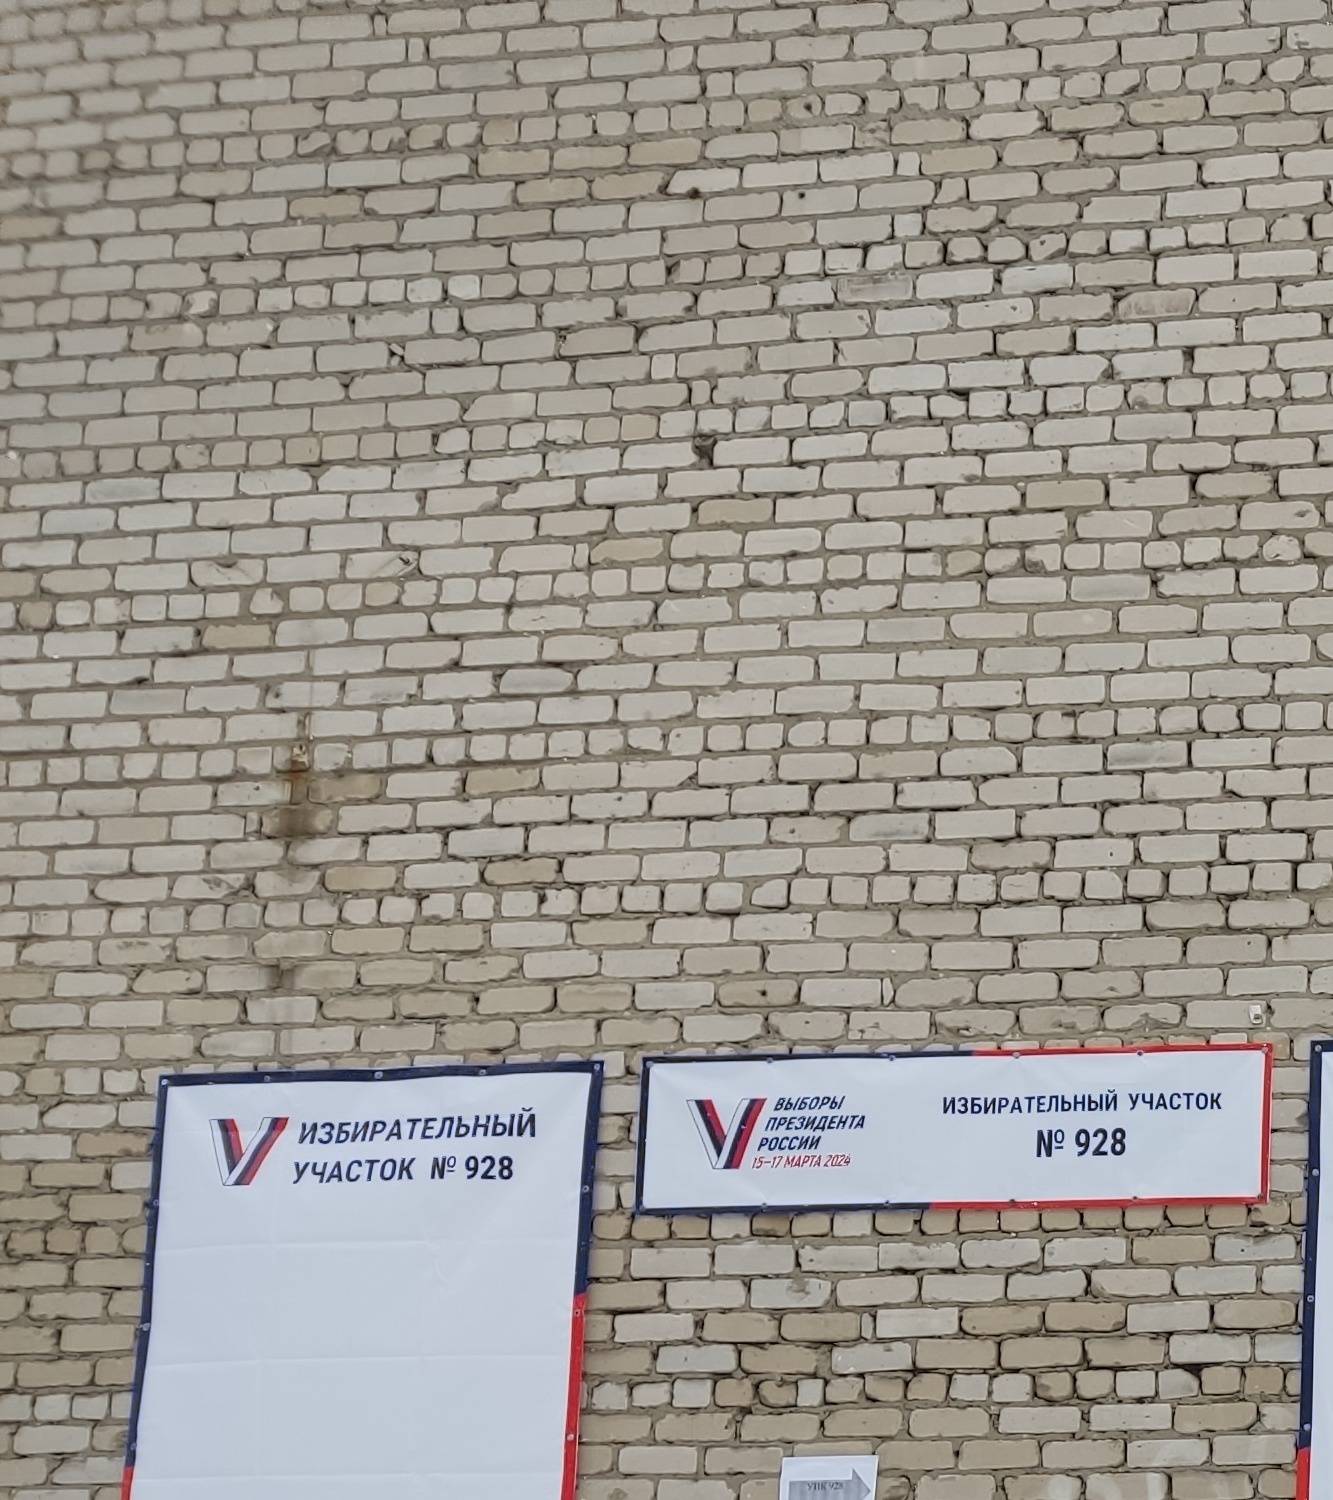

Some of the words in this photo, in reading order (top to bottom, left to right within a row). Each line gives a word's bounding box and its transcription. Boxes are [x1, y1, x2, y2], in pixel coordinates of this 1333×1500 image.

[773, 1096, 845, 1111] ВЫБОРЫ
[943, 1087, 1117, 1114] ИЗБИРАТЕЛЬНЫЙ
[1128, 1093, 1222, 1111] УЧАСТОК
[298, 1107, 536, 1144] ИЗБИРАТЕЛЬНЫЙ
[765, 1115, 865, 1132] ПРЕЗИДЕНТА
[757, 1136, 821, 1151] РОССИИ
[1036, 1129, 1065, 1157] №
[1075, 1128, 1126, 1157] 928
[293, 1158, 416, 1184] УЧАСТОК
[431, 1156, 456, 1180] №
[465, 1156, 513, 1180] 928
[784, 1155, 821, 1168] МАРТА
[823, 1154, 850, 1167] 2024
